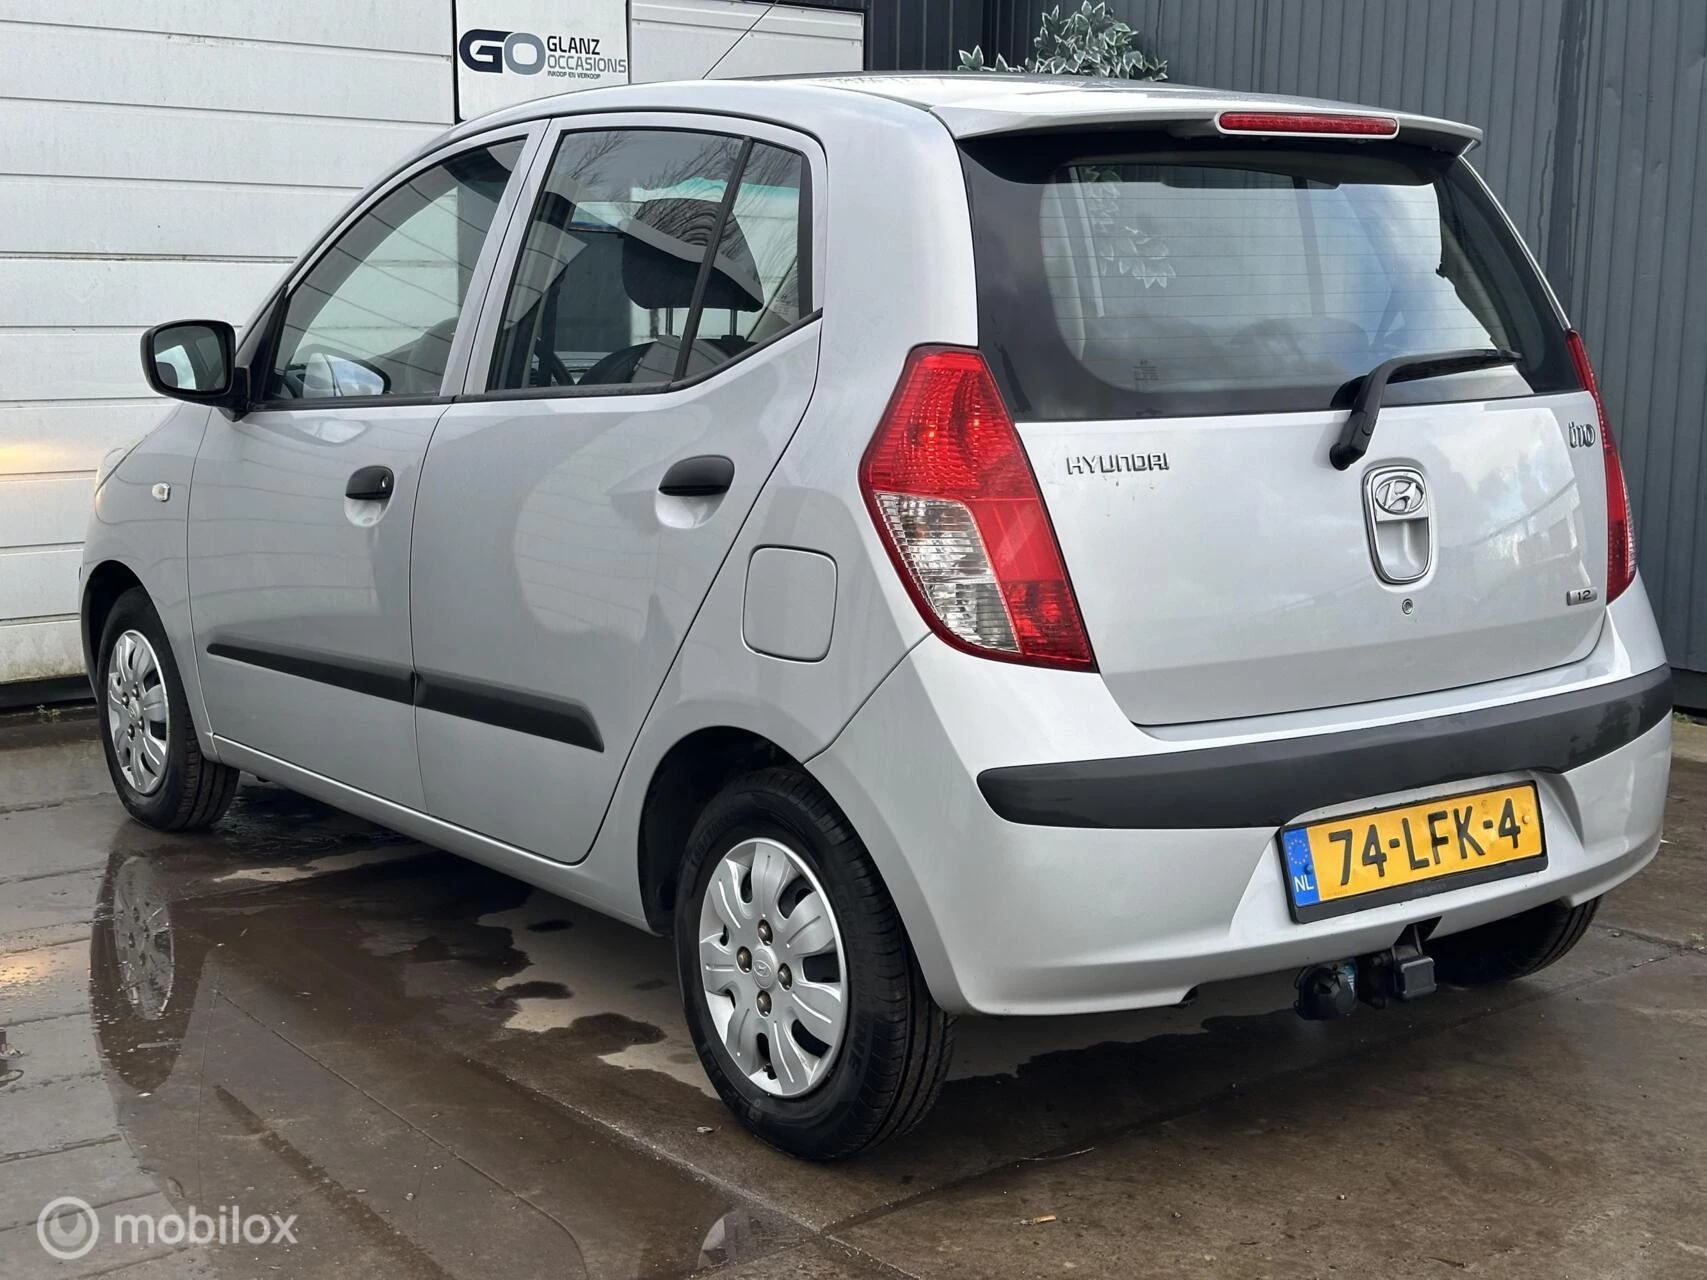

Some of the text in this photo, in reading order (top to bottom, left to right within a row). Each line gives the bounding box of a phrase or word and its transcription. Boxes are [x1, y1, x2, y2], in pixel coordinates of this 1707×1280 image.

[458, 28, 546, 76] GO
[547, 35, 601, 55] GLANZ
[547, 54, 627, 73] OCCASIONS
[547, 70, 601, 80] INKOOP EN VERKOOP
[1066, 453, 1170, 475] HYUNDAI
[1328, 797, 1521, 886] 74-LFK-4
[1294, 875, 1314, 893] NL
